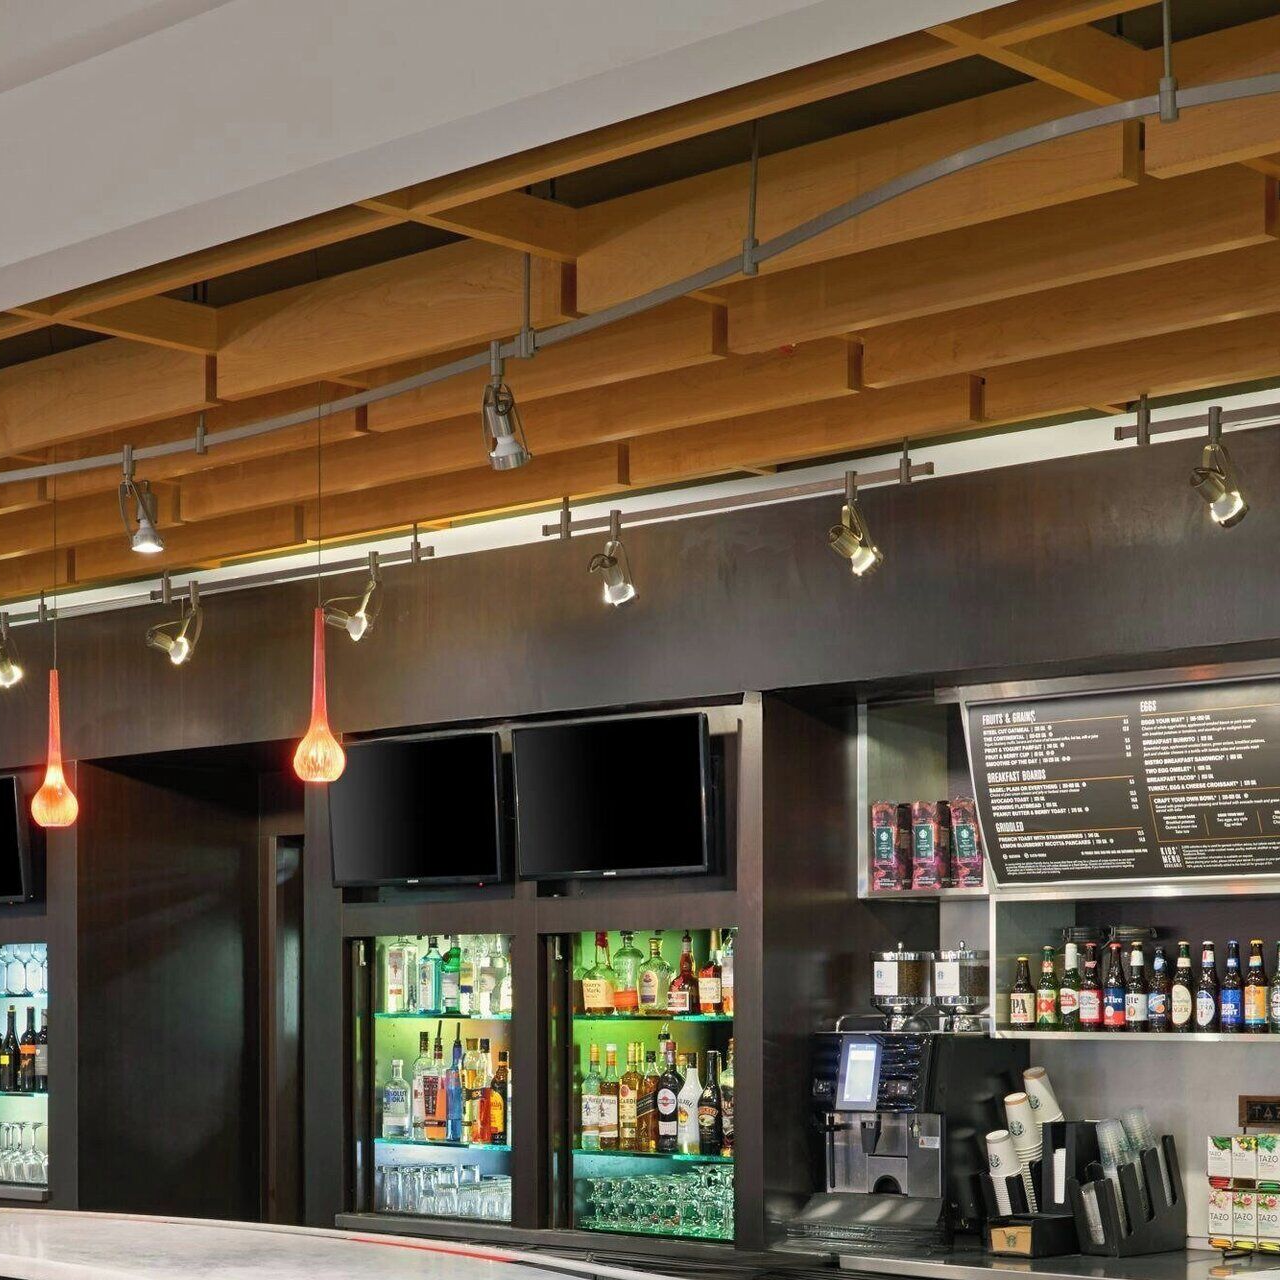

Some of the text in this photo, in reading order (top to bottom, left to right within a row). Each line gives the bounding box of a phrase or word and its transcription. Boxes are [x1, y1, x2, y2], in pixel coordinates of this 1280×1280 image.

[982, 712, 1003, 726] FRUITS
[1006, 713, 1011, 723] &
[987, 769, 1046, 783] BREAKFAST BOARDS
[995, 821, 1024, 832] GRIDDLED
[1010, 999, 1027, 1014] PA
[1259, 1155, 1278, 1163] TAZO
[1234, 1213, 1253, 1221] TAZO
[1259, 1214, 1277, 1222] TAZO
